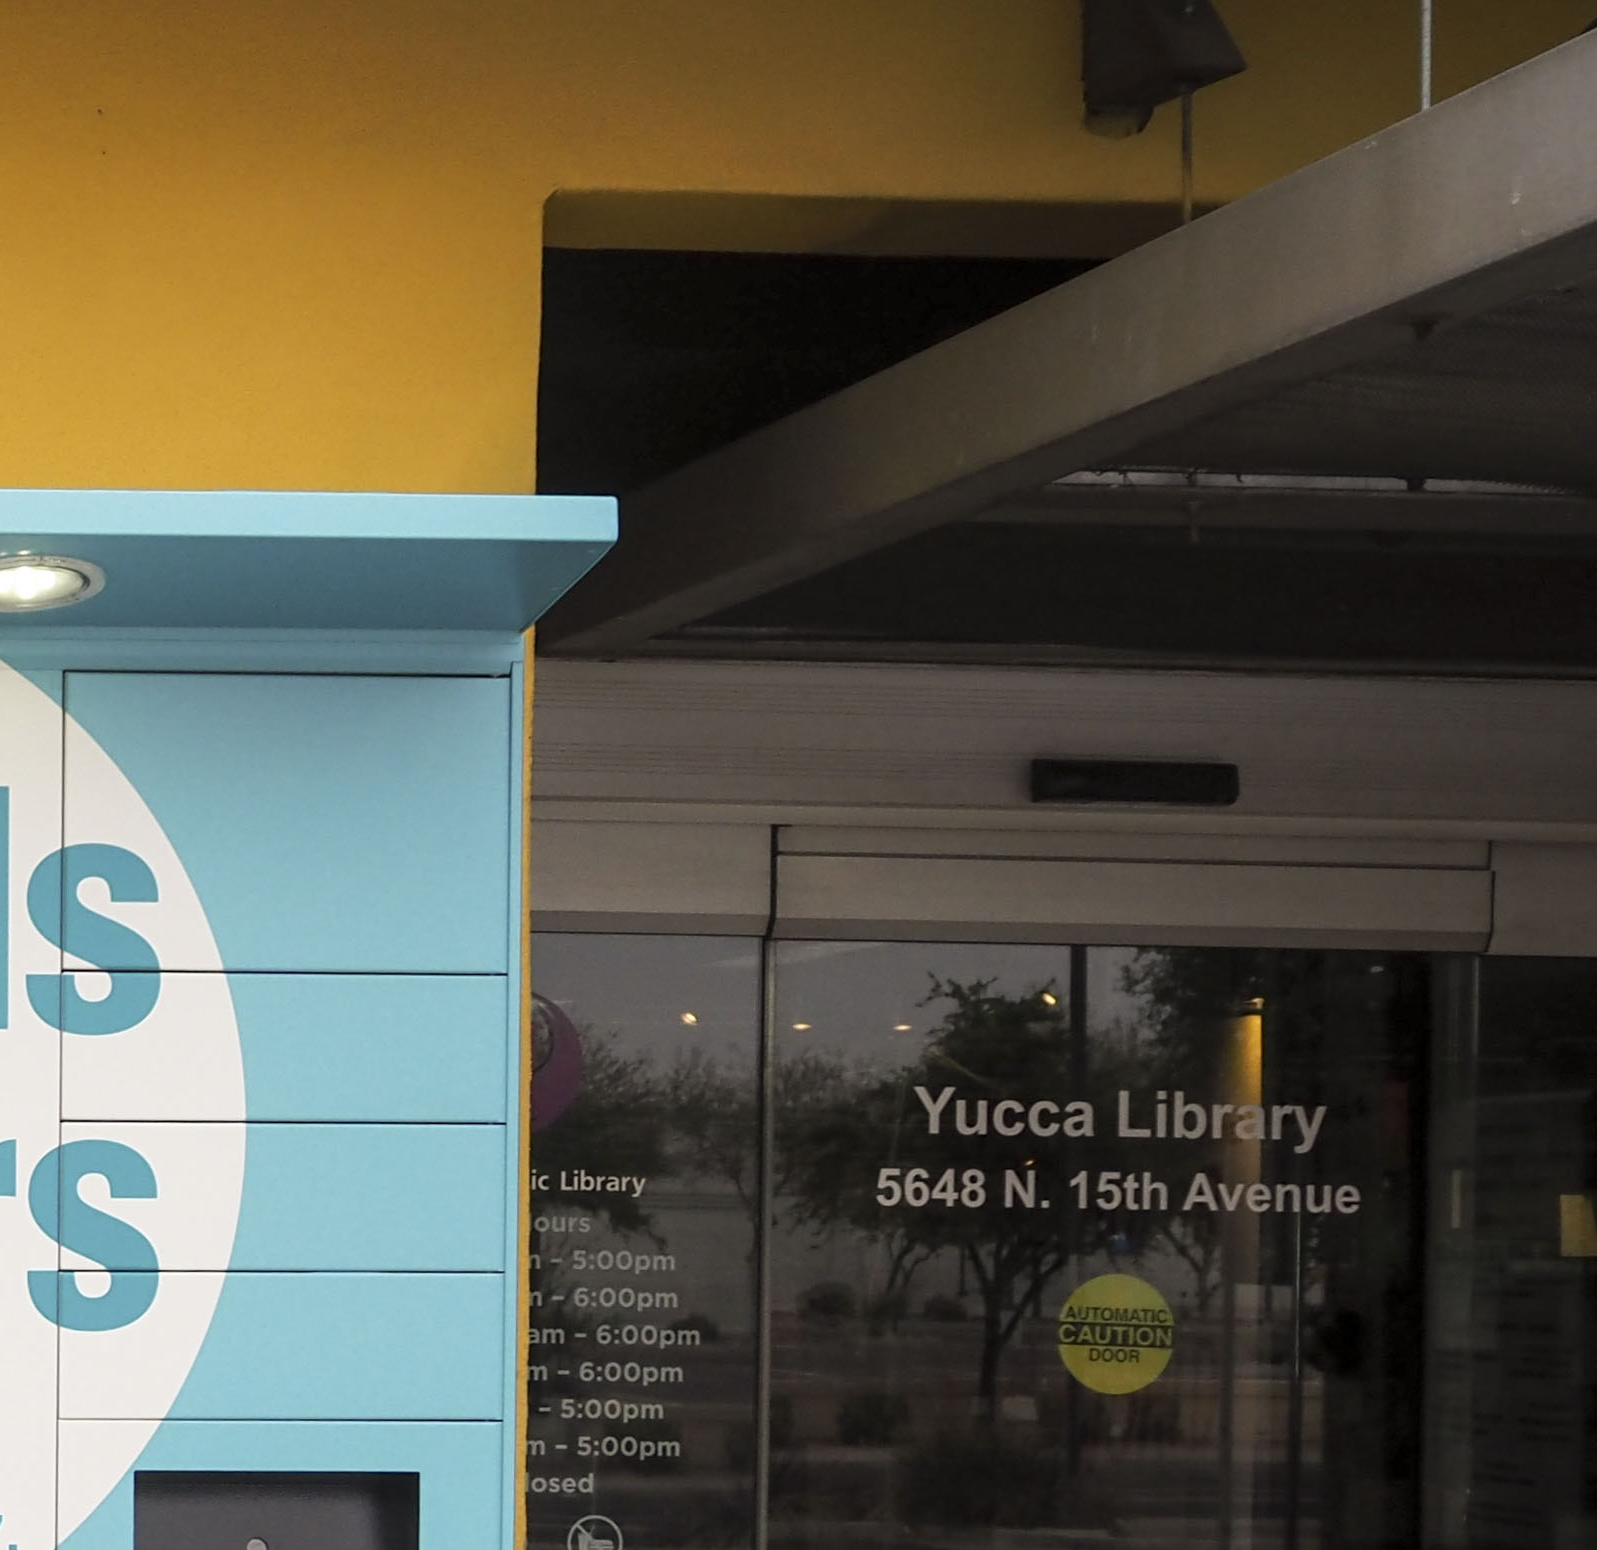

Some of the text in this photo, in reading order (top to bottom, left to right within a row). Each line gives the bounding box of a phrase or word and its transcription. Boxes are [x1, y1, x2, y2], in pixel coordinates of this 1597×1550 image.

[913, 1086, 1328, 1154] Yucca Library
[560, 1170, 646, 1197] Library
[875, 1168, 1361, 1214] 5648 N. 15th Avenue
[530, 1214, 592, 1233] ours
[572, 1249, 676, 1275] 5:00pm
[574, 1287, 679, 1312] 6:00pm
[1065, 1306, 1169, 1324] AUTOMATIC
[596, 1324, 701, 1349] 6:00pm
[1058, 1324, 1172, 1346] CAUTION
[1088, 1347, 1140, 1364] DOOR
[579, 1362, 685, 1386] 6:00pm
[560, 1398, 665, 1423] 5:00pm
[577, 1436, 681, 1460] 5:00pm
[526, 1474, 595, 1494] losed
